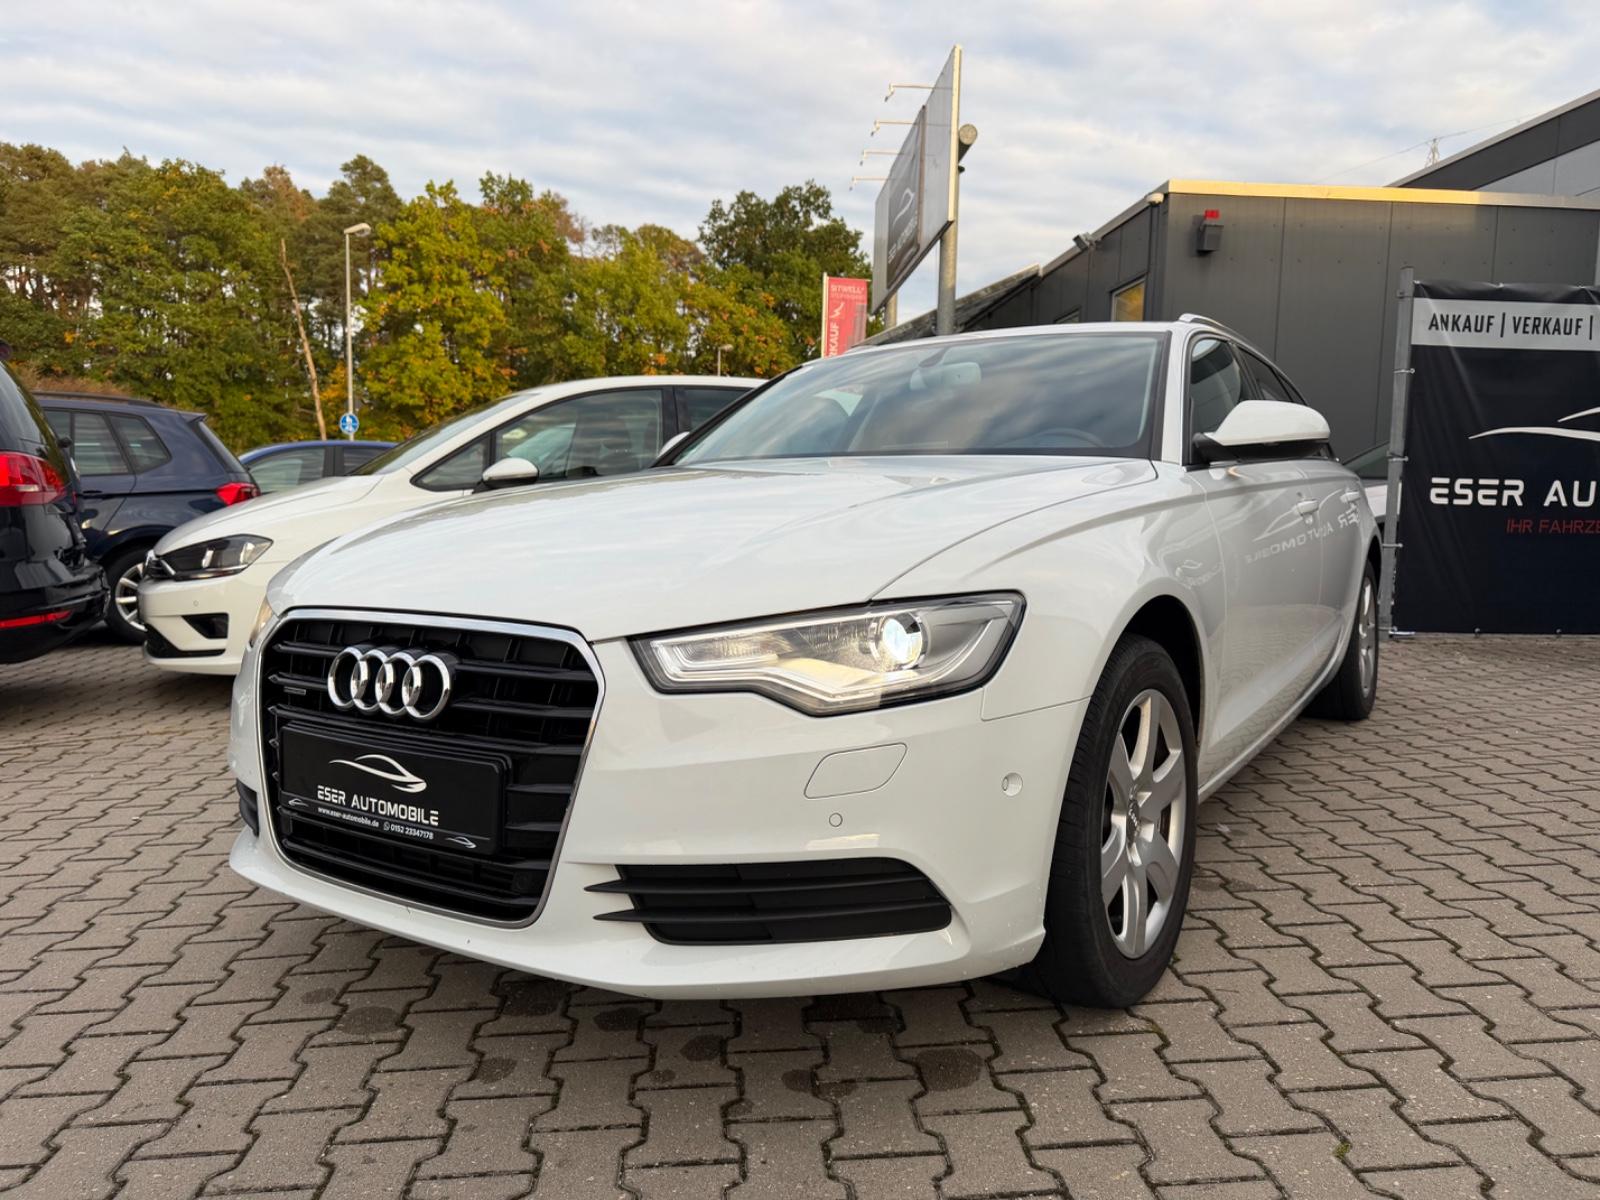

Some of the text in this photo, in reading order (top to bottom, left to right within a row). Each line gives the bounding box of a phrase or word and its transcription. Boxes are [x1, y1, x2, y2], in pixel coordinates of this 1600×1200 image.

[1428, 312, 1495, 333] ANKAUF
[1512, 315, 1583, 336] VERKAUF
[1430, 477, 1597, 508] ESER AU
[1506, 519, 1533, 534] IHR
[317, 785, 439, 827] ESER AUTOMOBILE
